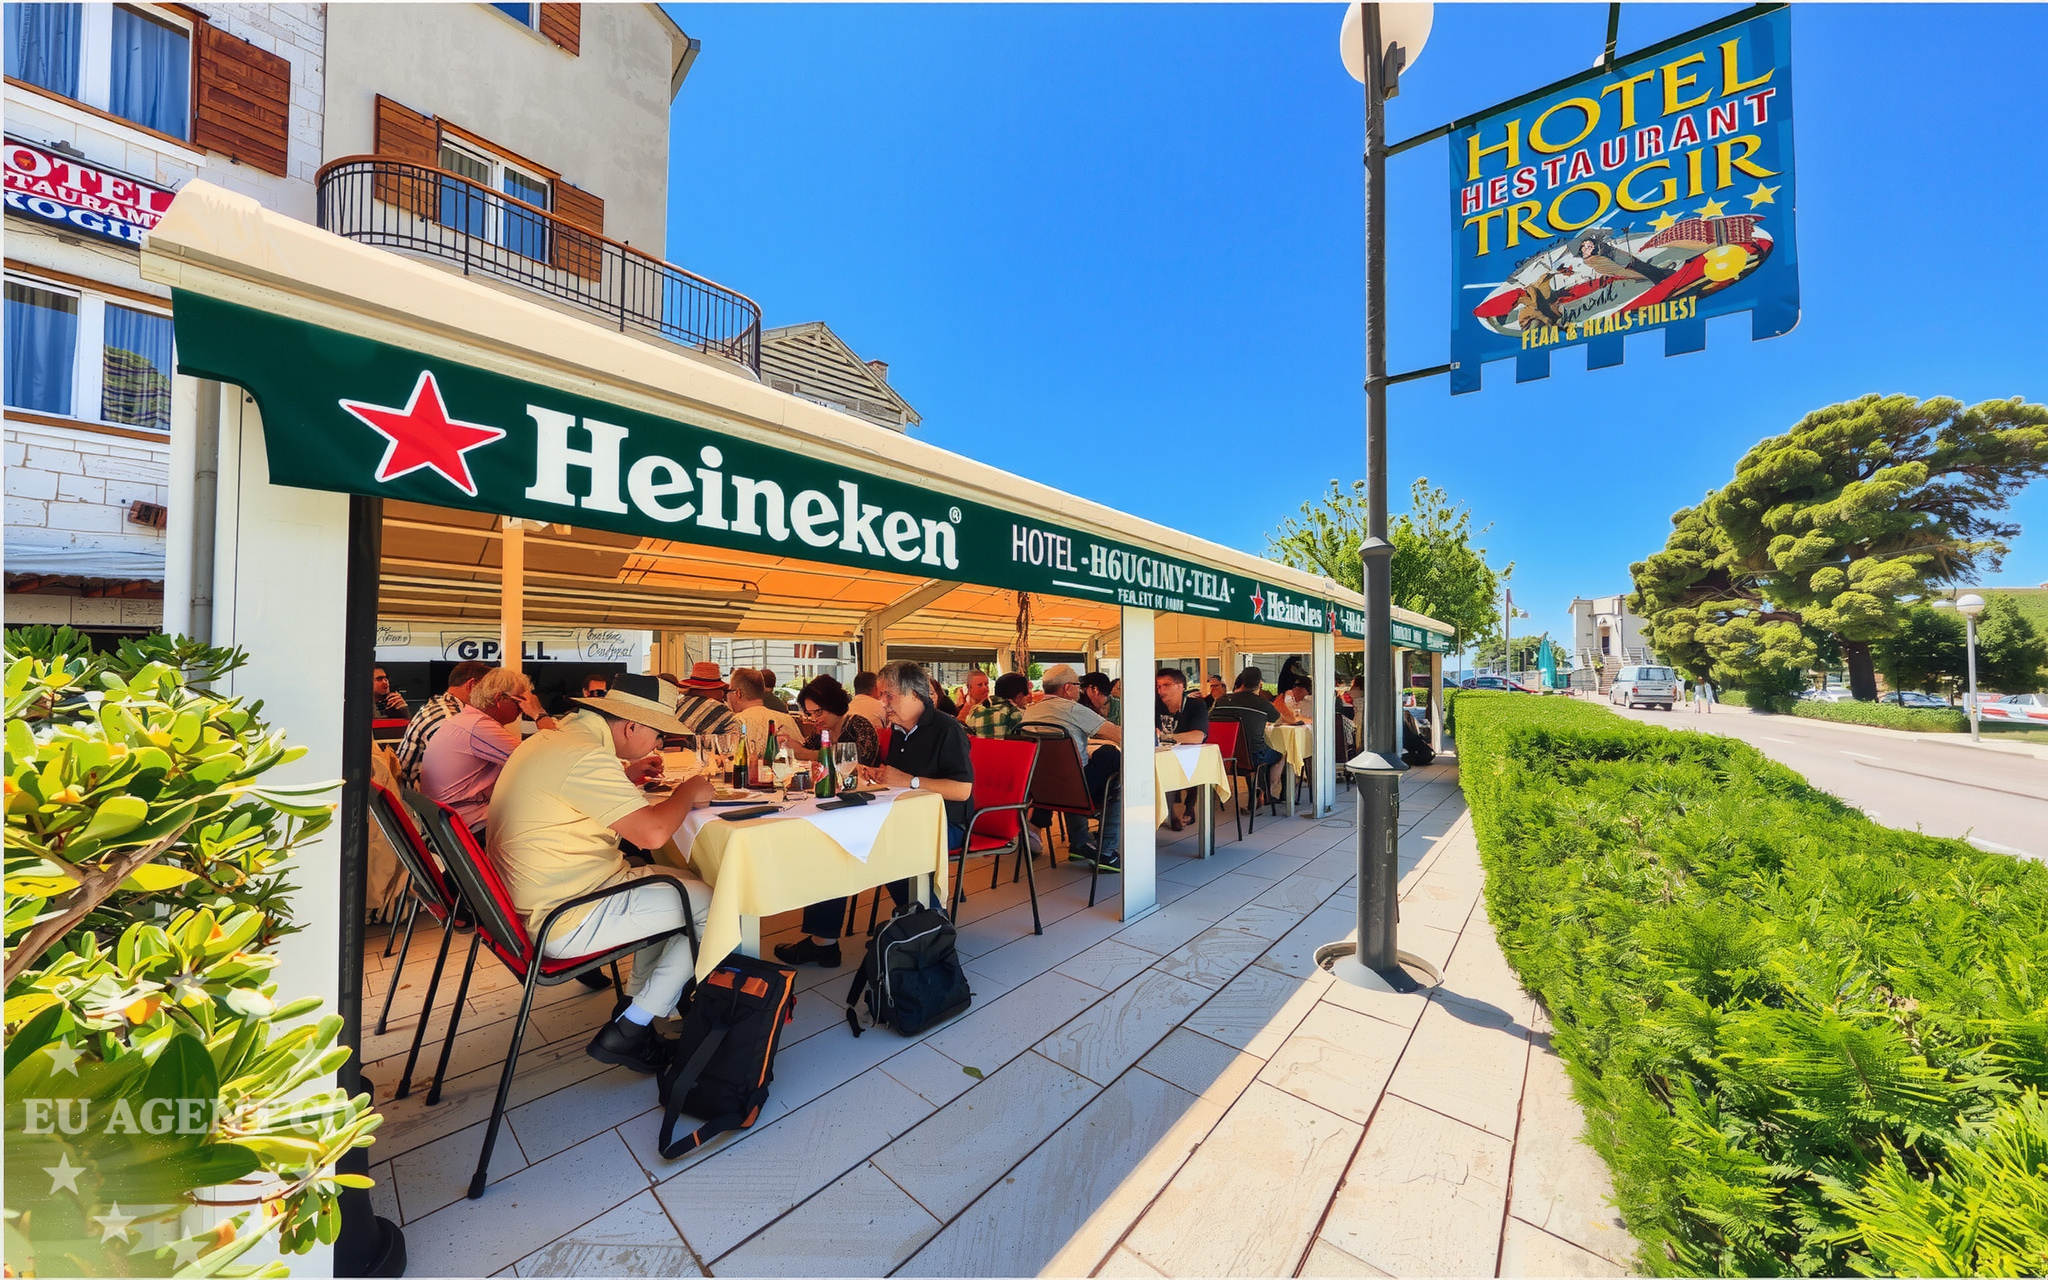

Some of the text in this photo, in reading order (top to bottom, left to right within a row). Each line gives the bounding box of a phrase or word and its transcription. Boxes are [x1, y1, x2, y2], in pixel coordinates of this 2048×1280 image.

[1465, 36, 1776, 182] HOTEL
[1462, 134, 1783, 258] TROGIR
[1012, 524, 1077, 572] HOTEL
